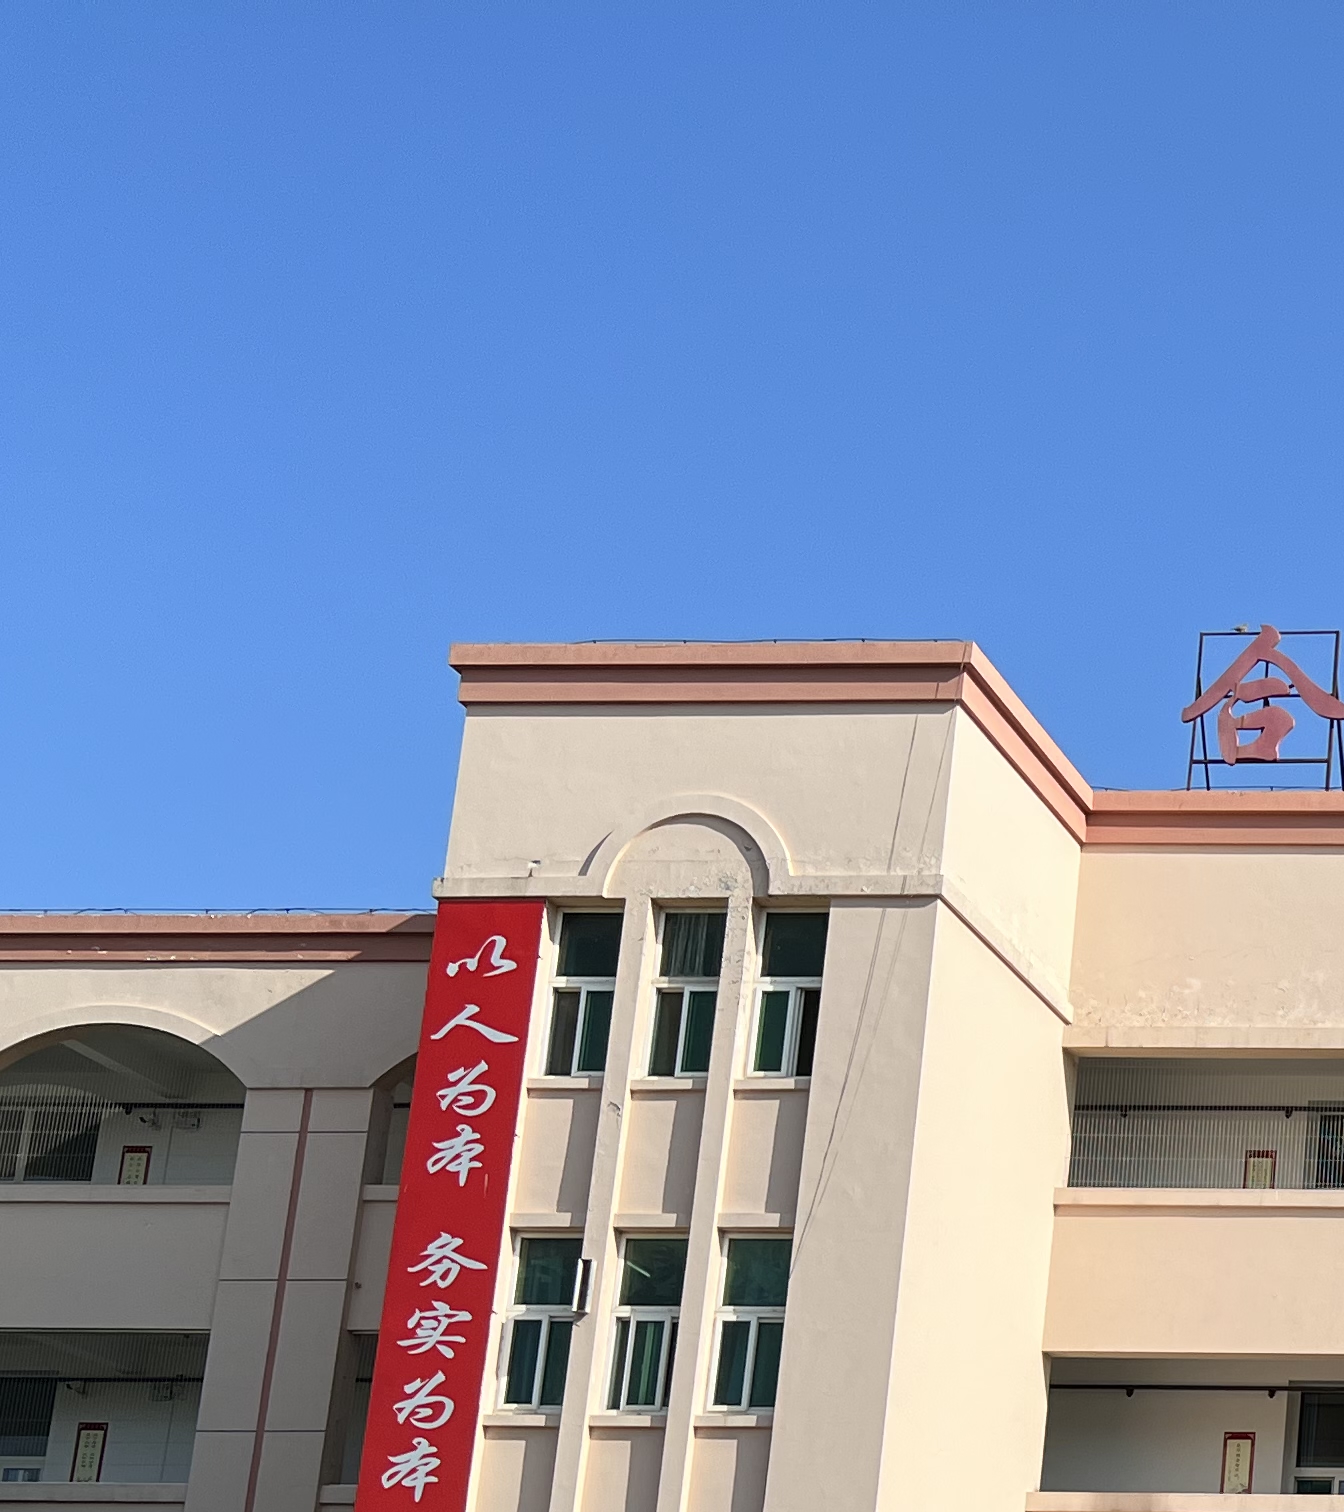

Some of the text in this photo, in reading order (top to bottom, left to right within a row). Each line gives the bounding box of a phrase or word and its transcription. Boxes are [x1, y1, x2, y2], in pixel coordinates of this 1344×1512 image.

[427, 935, 519, 1187] 以人为本
[382, 1232, 488, 1503] 务实为本
